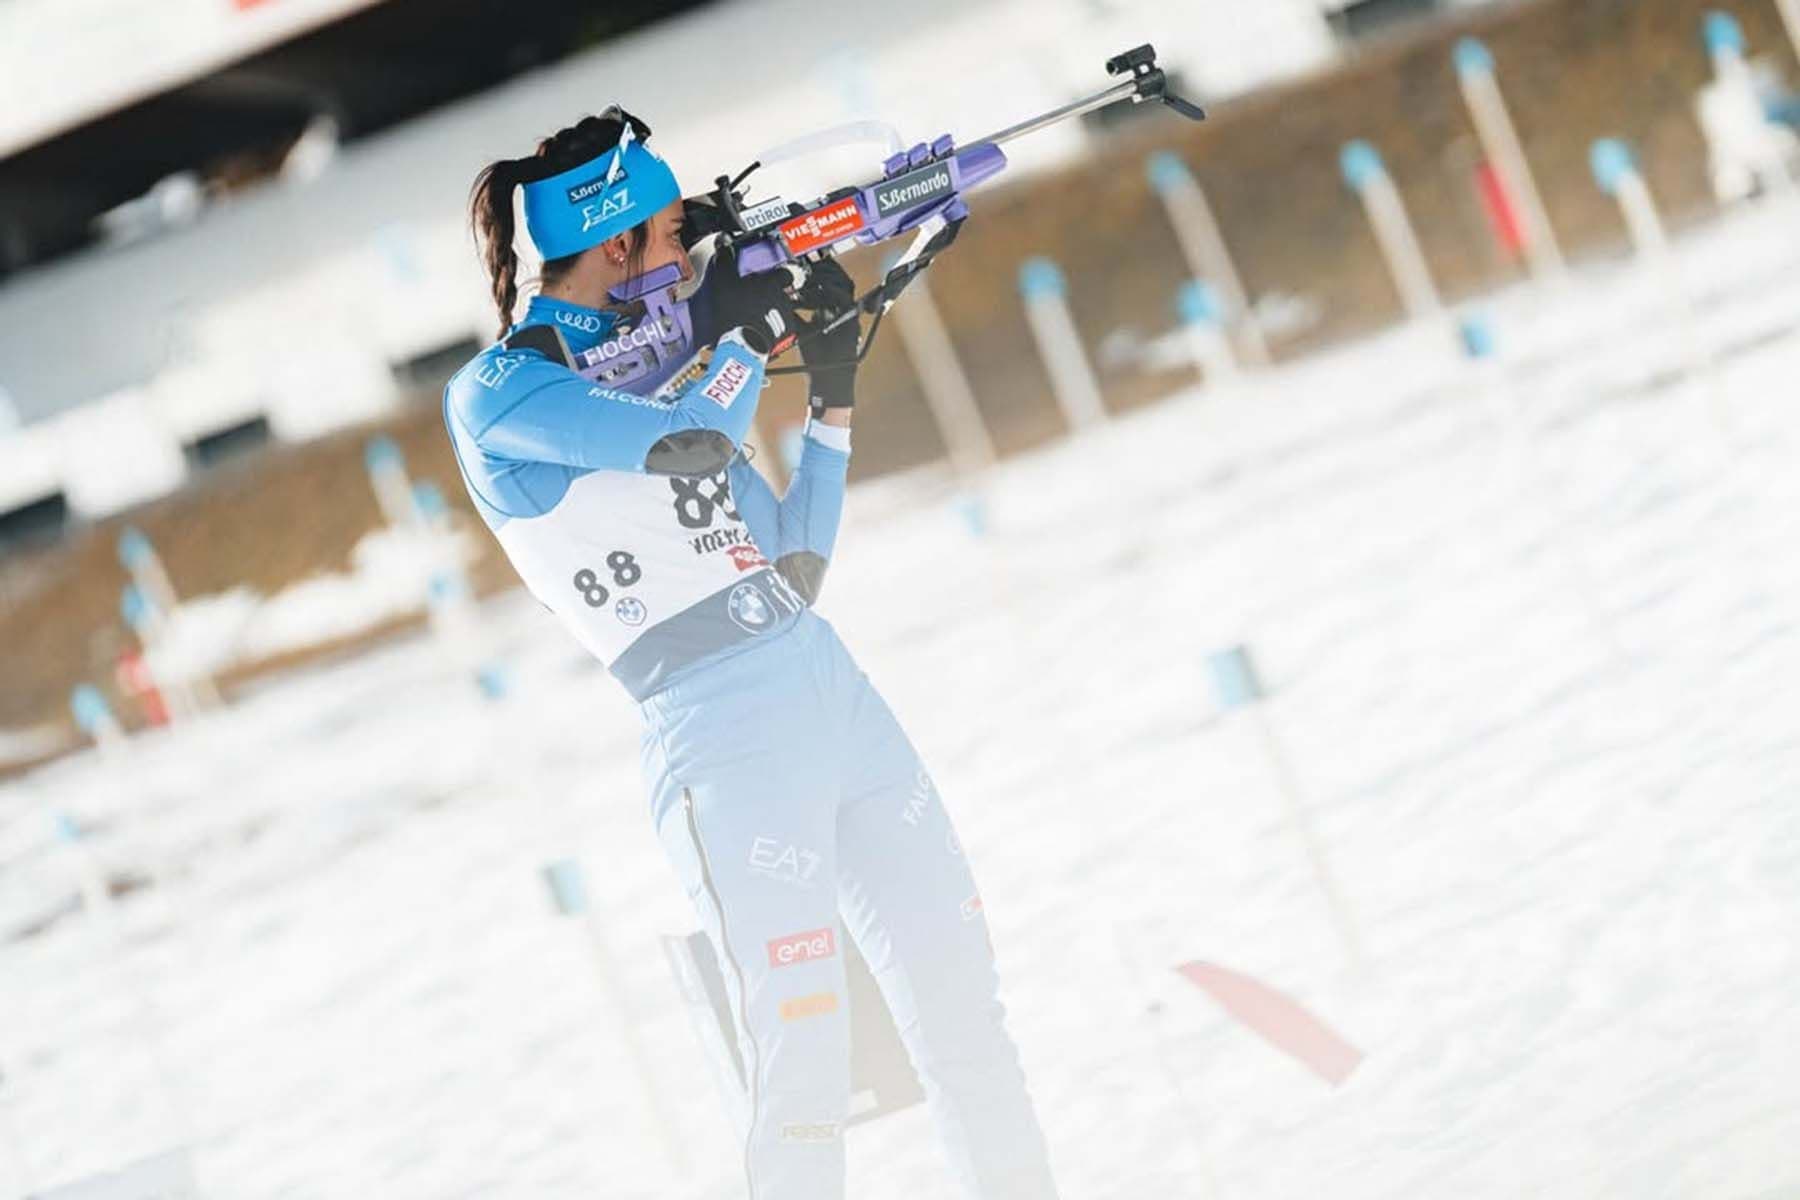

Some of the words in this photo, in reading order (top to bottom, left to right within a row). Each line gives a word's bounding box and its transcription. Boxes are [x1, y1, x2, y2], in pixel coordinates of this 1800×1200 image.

[878, 171, 949, 211] S.Bernardo
[784, 204, 857, 240] VIESSMANN
[583, 320, 667, 366] FIOCCHI
[574, 551, 641, 607] 88
[750, 836, 821, 880] EA7
[777, 931, 830, 963] enel
